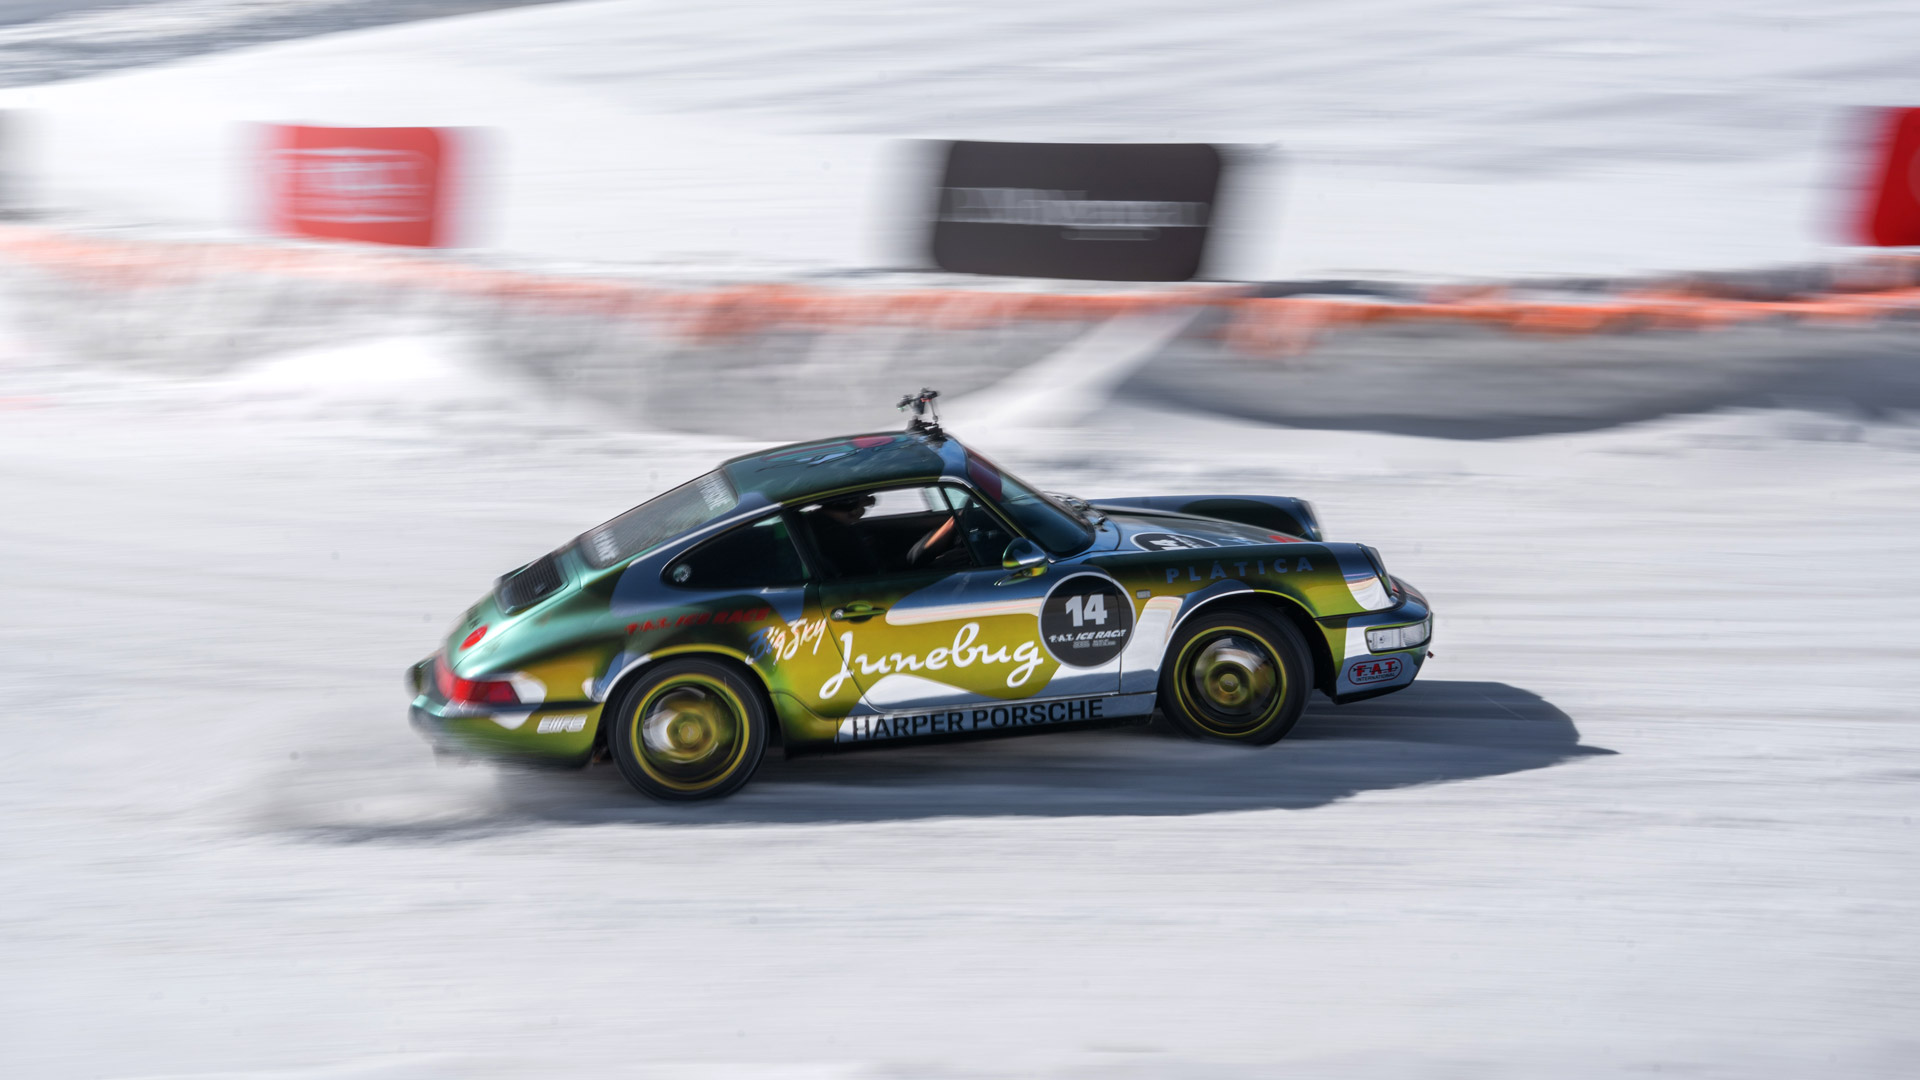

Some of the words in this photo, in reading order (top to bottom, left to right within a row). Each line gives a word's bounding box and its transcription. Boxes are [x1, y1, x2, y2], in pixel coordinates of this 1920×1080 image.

[1166, 557, 1314, 584] PLÁTICA
[712, 607, 771, 625] RACE
[1065, 593, 1108, 627] 14
[1075, 631, 1096, 641] ICE
[818, 622, 1044, 700] Junebug
[852, 710, 964, 742] HARPER
[972, 698, 1104, 730] PORSCHE
